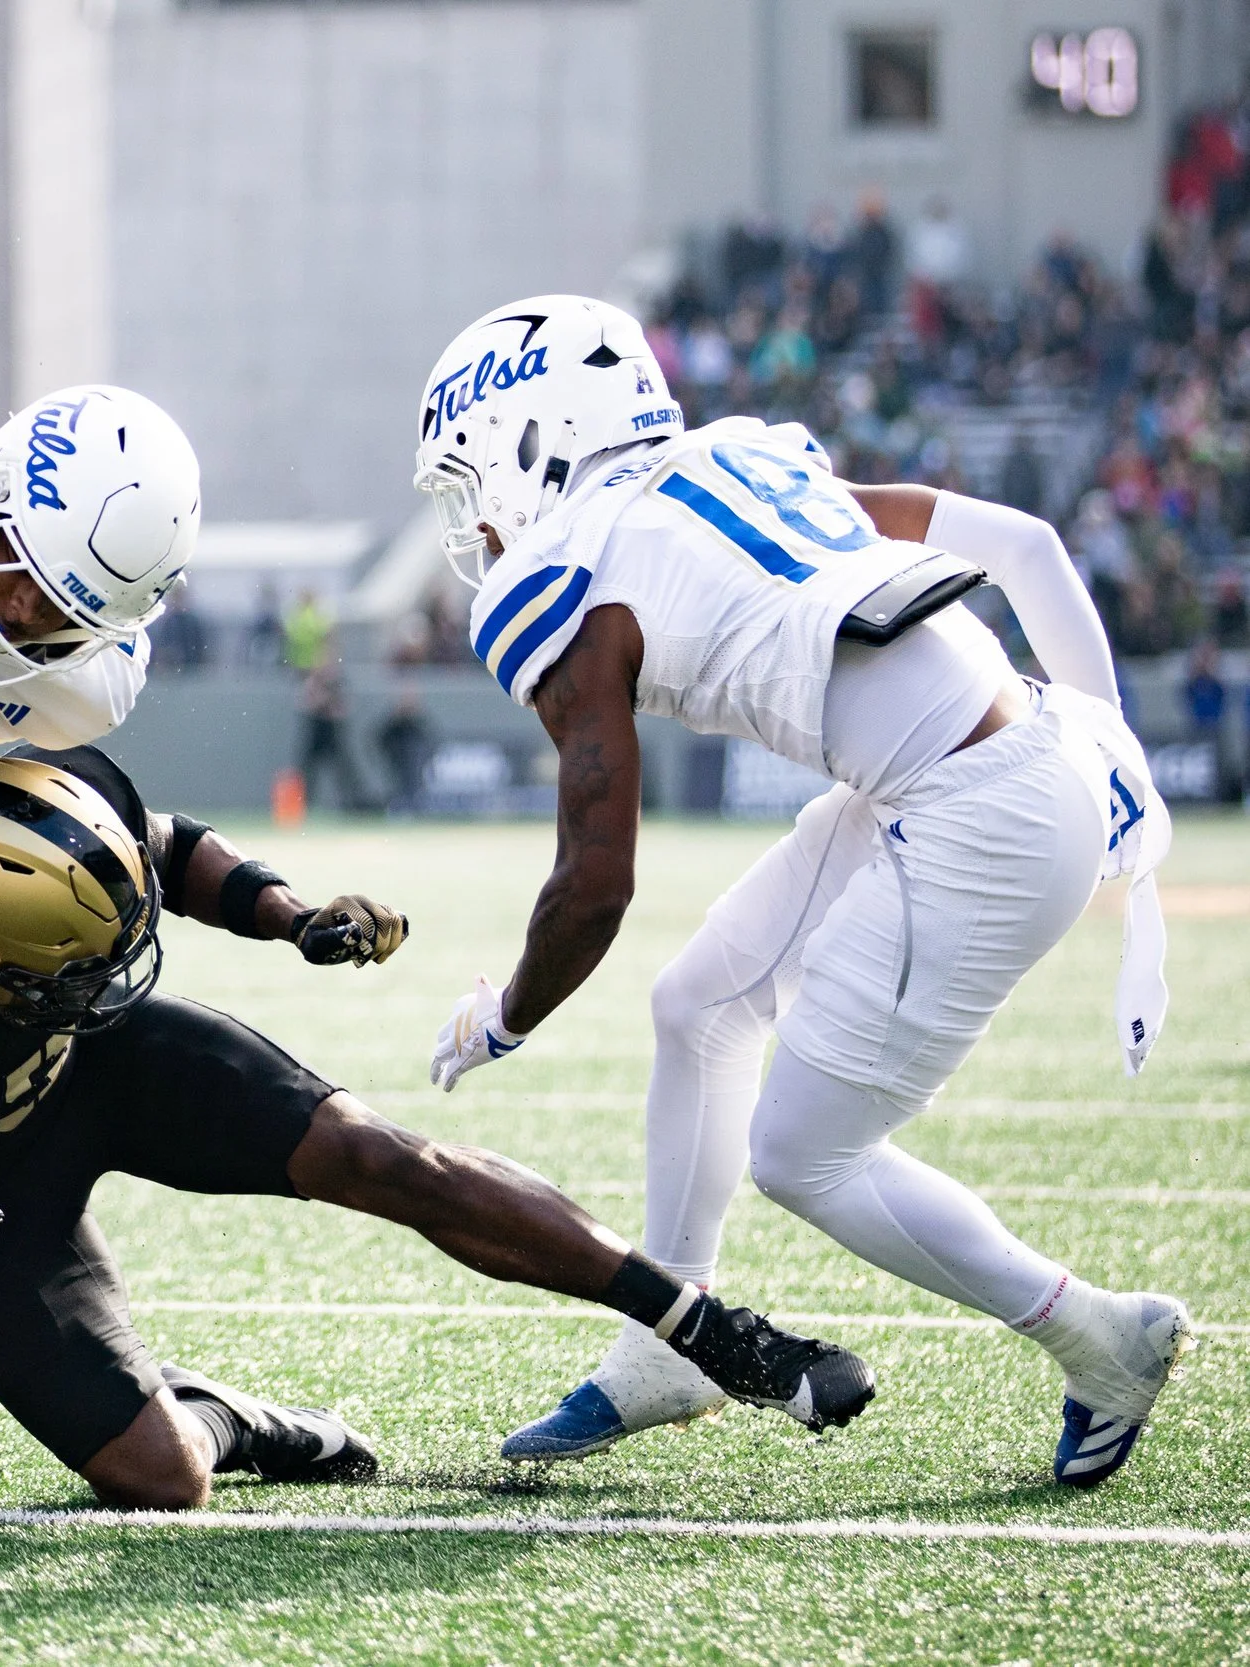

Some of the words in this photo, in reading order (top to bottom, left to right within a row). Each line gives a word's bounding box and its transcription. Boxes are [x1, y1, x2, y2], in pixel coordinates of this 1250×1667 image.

[429, 345, 548, 440] Tulsa
[26, 396, 89, 511] Tulsa
[656, 443, 880, 585] 18
[62, 571, 106, 613] TULSA
